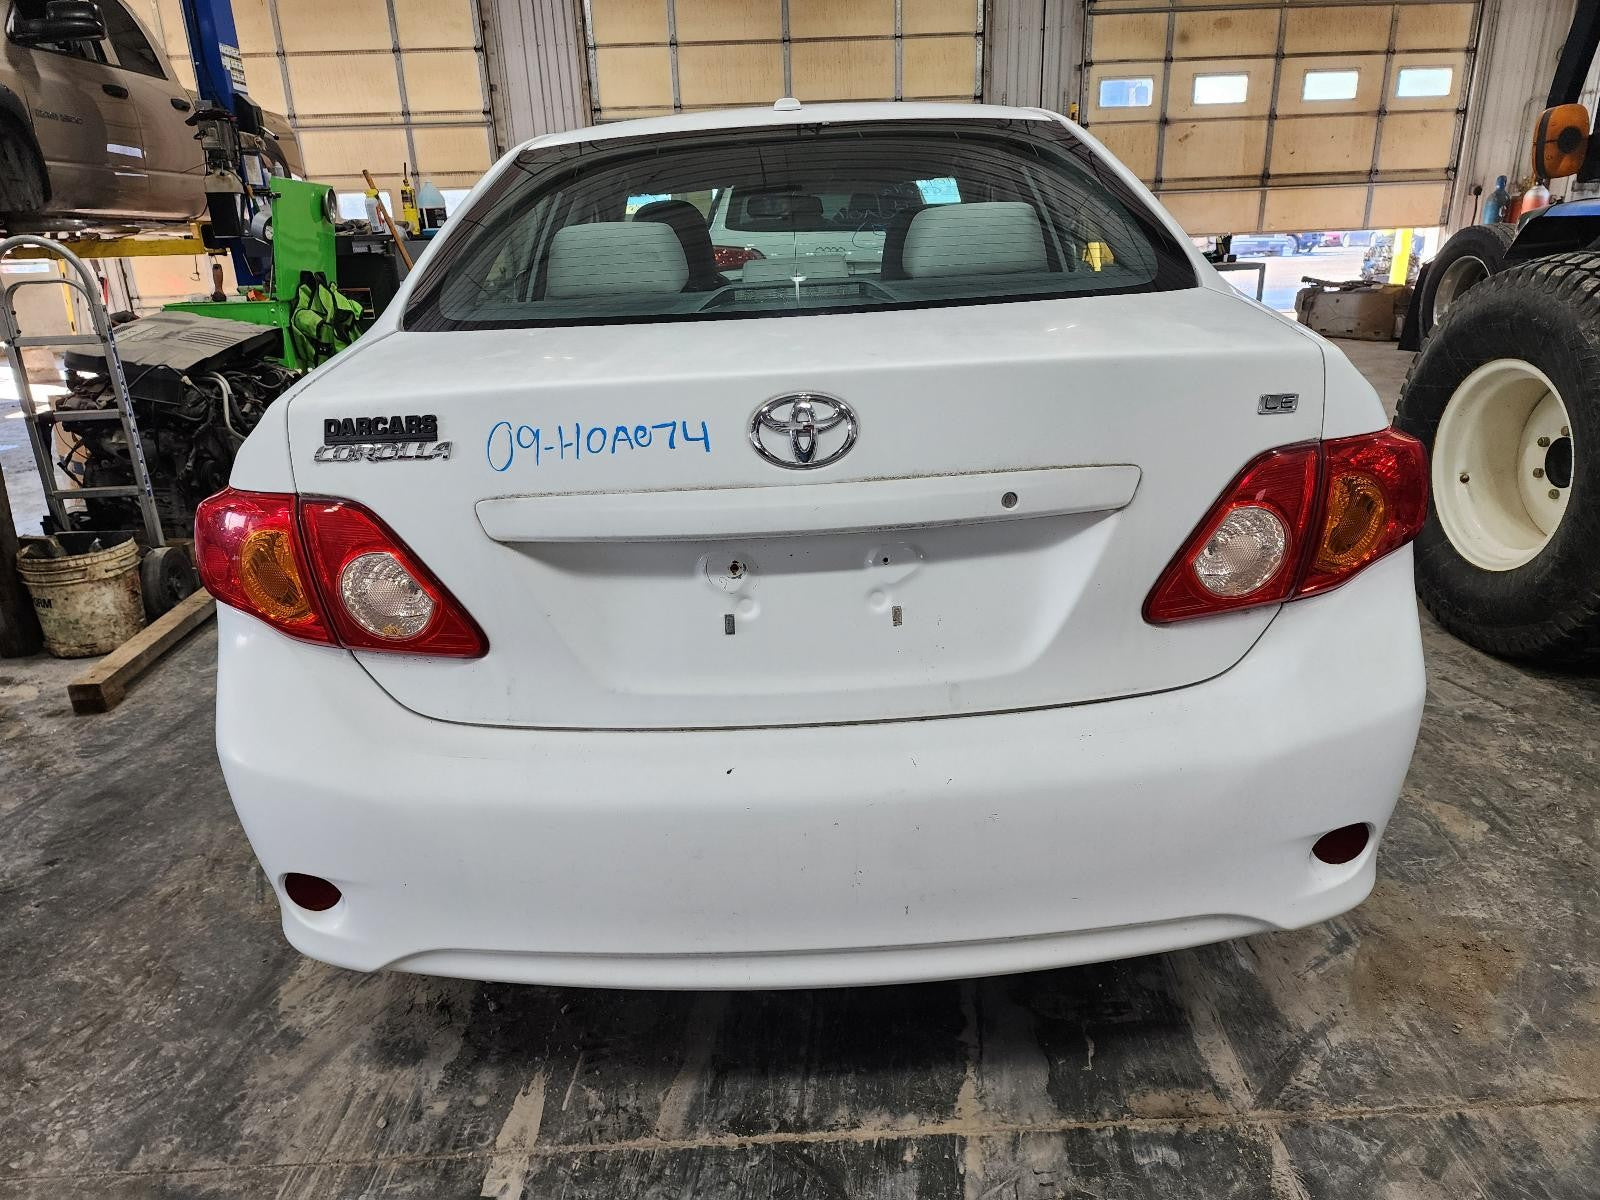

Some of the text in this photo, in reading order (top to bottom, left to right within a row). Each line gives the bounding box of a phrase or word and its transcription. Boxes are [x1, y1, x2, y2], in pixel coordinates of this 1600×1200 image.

[1261, 394, 1298, 411] LE
[323, 414, 438, 437] DARCARS
[313, 441, 452, 462] COROLLA
